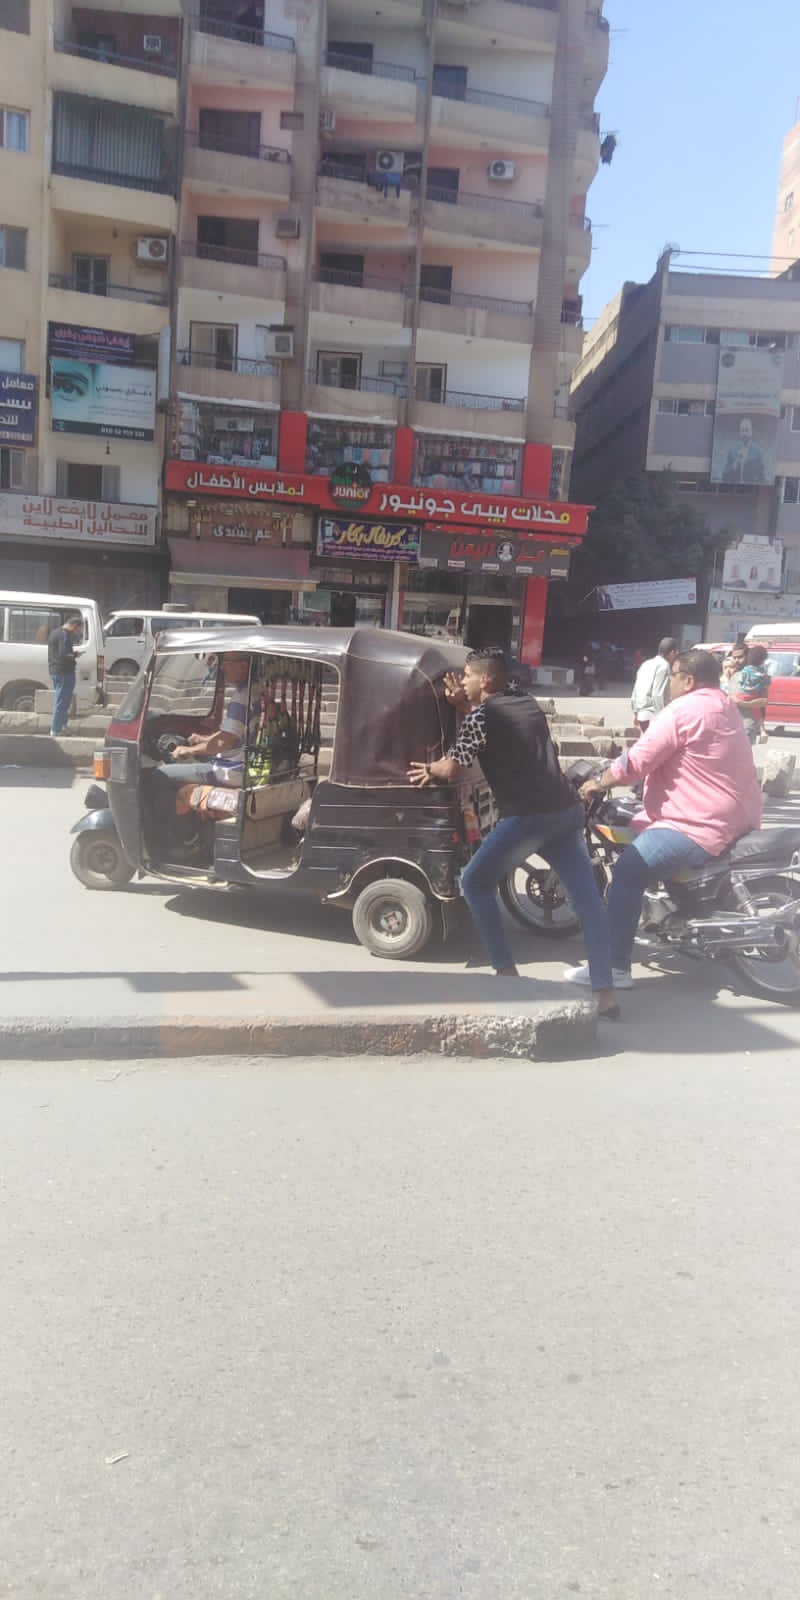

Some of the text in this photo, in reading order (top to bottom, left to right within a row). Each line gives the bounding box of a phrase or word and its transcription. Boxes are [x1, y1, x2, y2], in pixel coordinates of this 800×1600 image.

[2, 376, 33, 391] معامل
[187, 471, 304, 496] لملابس الأطفال
[22, 497, 53, 515] لاين
[101, 505, 148, 521] معمل
[379, 491, 455, 517] جونيور
[512, 504, 570, 525] محلات
[23, 514, 148, 536] للتحاليل الطبية
